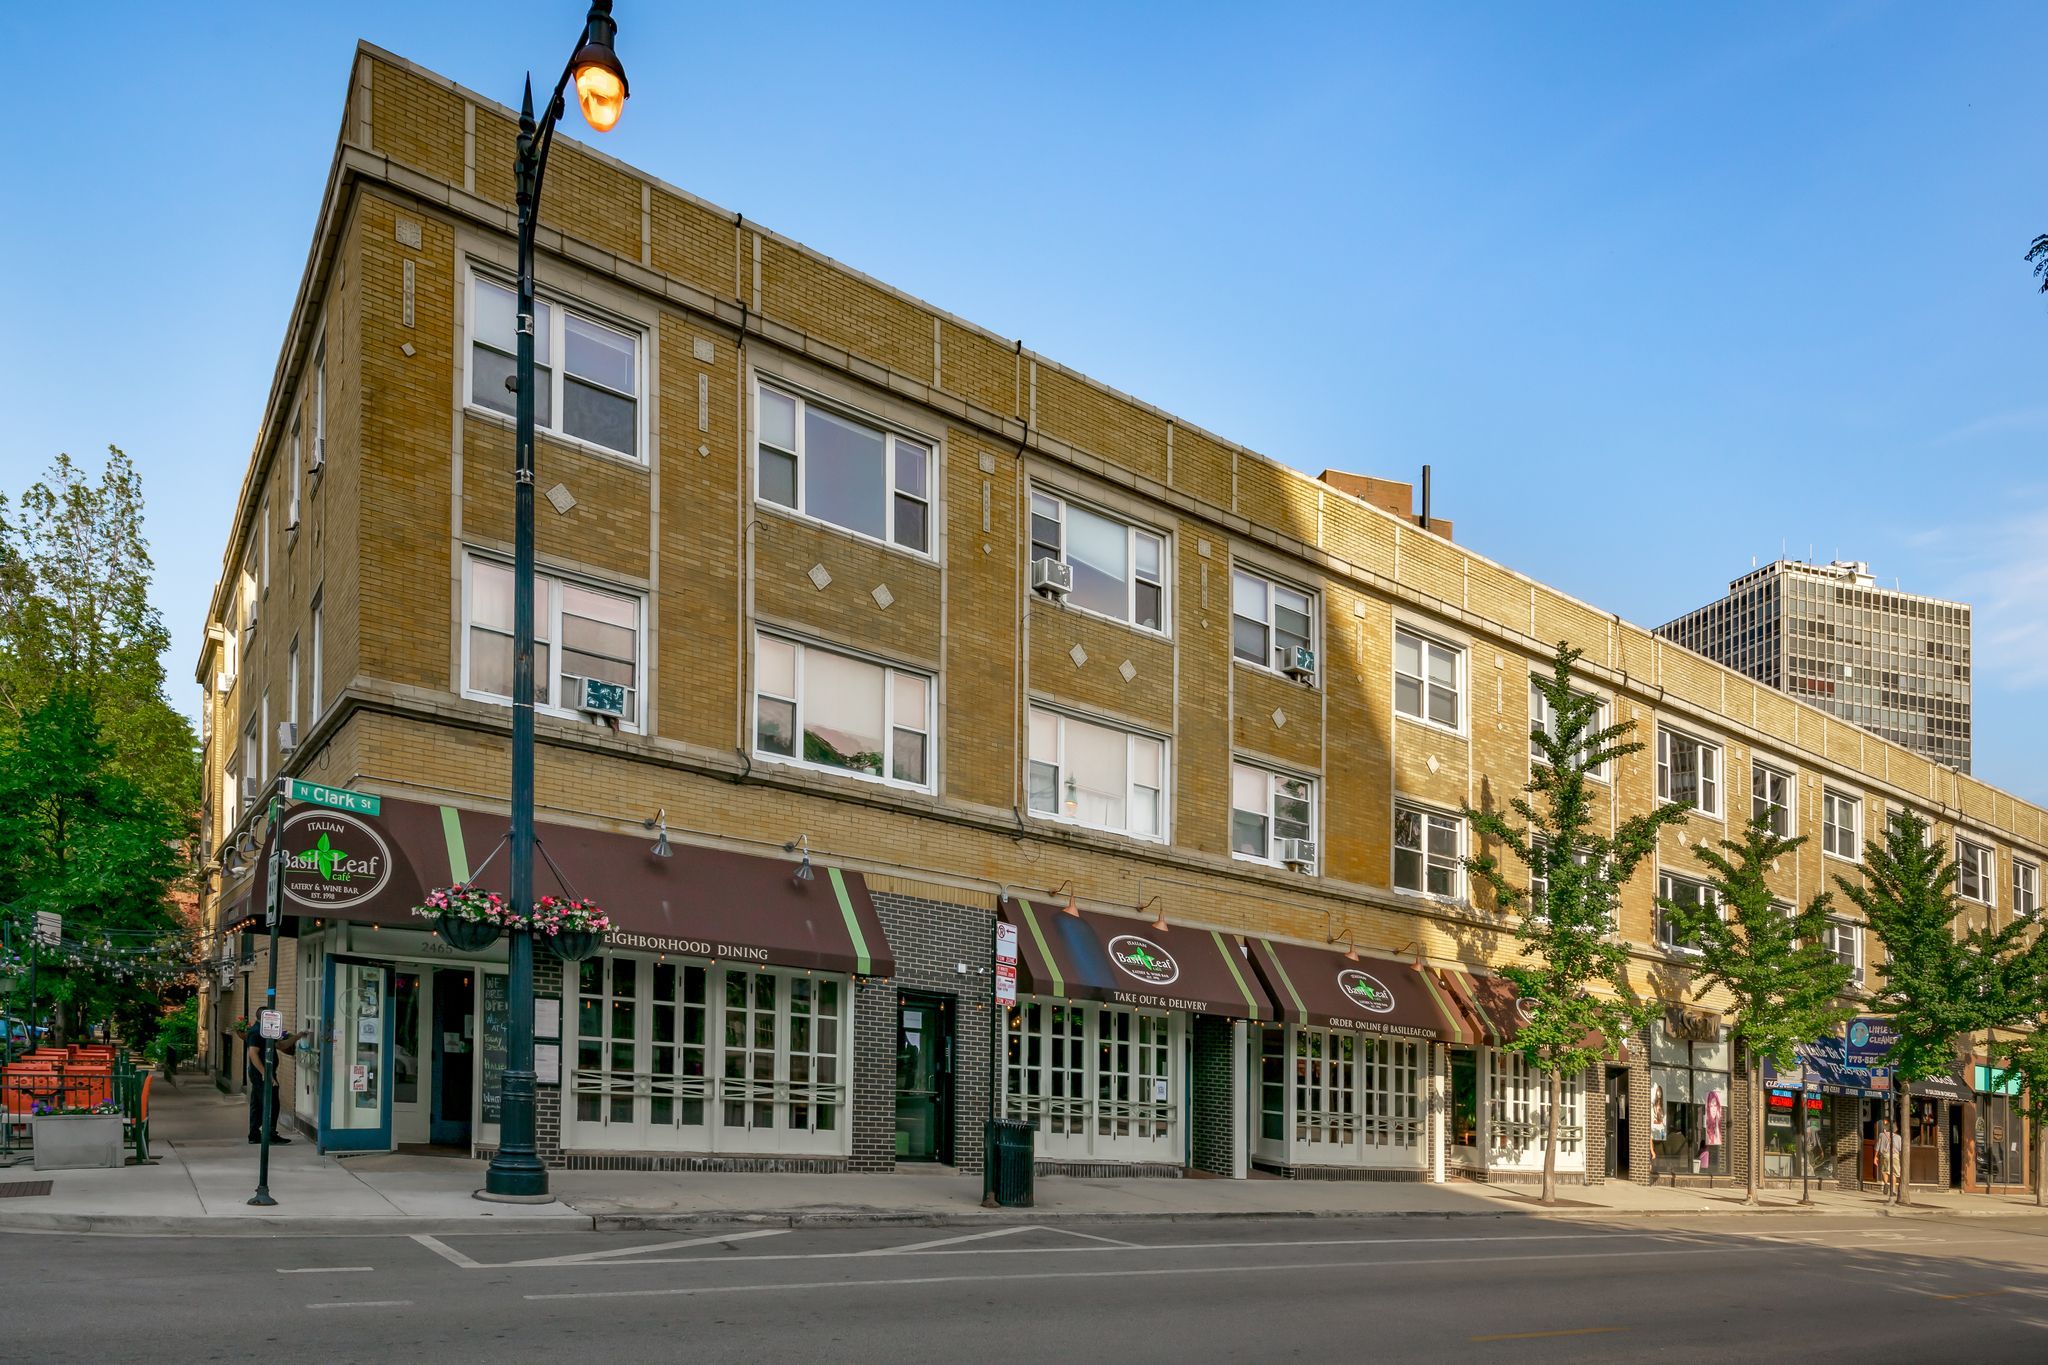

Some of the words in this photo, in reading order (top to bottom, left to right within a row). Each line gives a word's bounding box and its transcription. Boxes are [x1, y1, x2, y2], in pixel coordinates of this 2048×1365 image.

[301, 787, 308, 796] N
[313, 787, 355, 808] Clark
[361, 799, 371, 809] St
[307, 822, 345, 833] ITALIAN
[282, 849, 319, 870] Basil
[332, 852, 379, 875] Leaf
[332, 872, 351, 882] café
[291, 882, 313, 891] EATERY
[314, 883, 320, 891] &
[322, 885, 342, 893] WINE
[343, 886, 359, 895] BAR
[421, 942, 454, 954] 2465
[604, 932, 711, 954] EIGHBORHOOD
[717, 944, 769, 960] DINING
[1116, 951, 1144, 965] Basil
[1148, 956, 1171, 969] Leaf
[486, 977, 503, 988] WE
[1113, 991, 1137, 1003] TAKE
[1139, 994, 1158, 1006] OUT
[1160, 998, 1167, 1006] &
[1168, 998, 1208, 1011] DELIVERY
[1329, 1017, 1353, 1028] ORDER
[1355, 1020, 1381, 1032] ONLINE
[1382, 1024, 1389, 1033] @
[1390, 1025, 1437, 1038] BASILLEAF.COM
